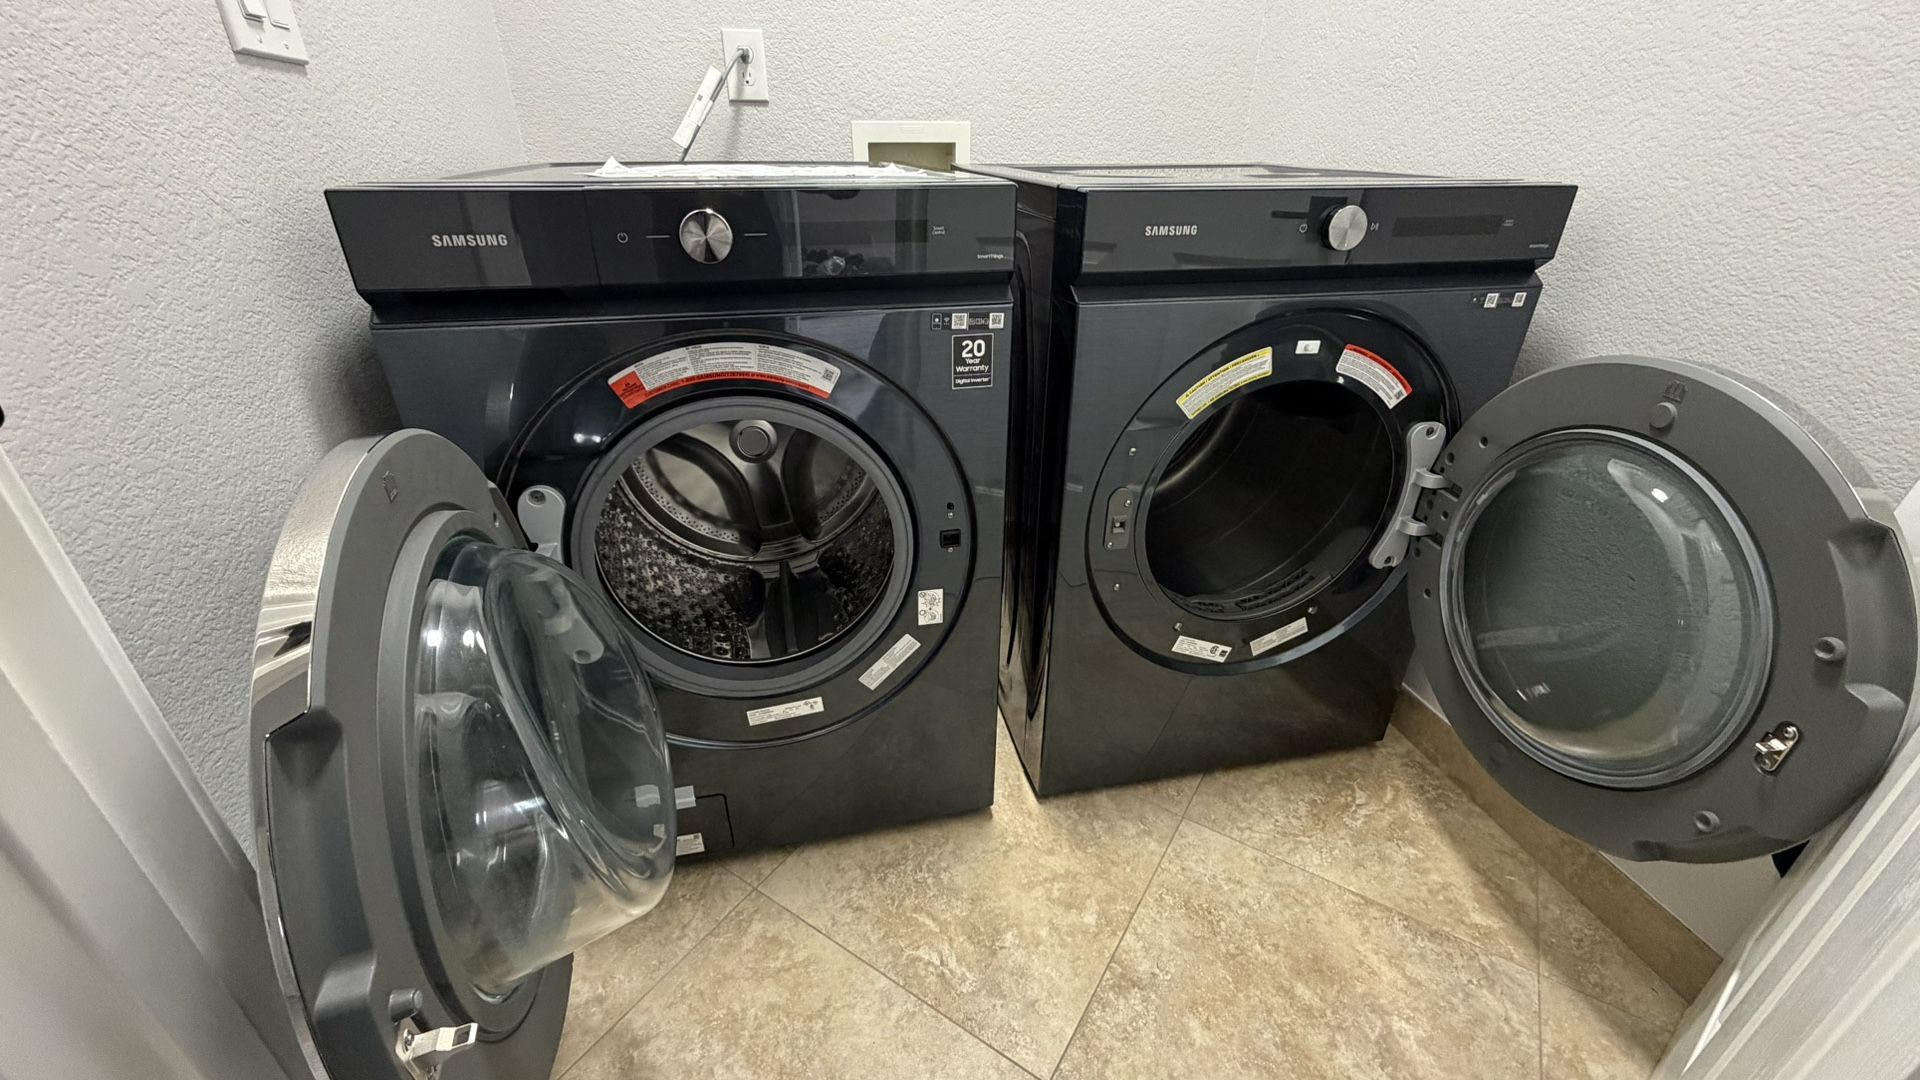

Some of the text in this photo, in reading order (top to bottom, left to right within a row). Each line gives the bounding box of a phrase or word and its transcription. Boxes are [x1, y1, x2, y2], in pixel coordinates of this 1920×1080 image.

[1145, 225, 1197, 236] SAMSUNG
[432, 234, 508, 247] SAMSUNG
[961, 339, 986, 358] 20
[955, 364, 989, 373] Warranty
